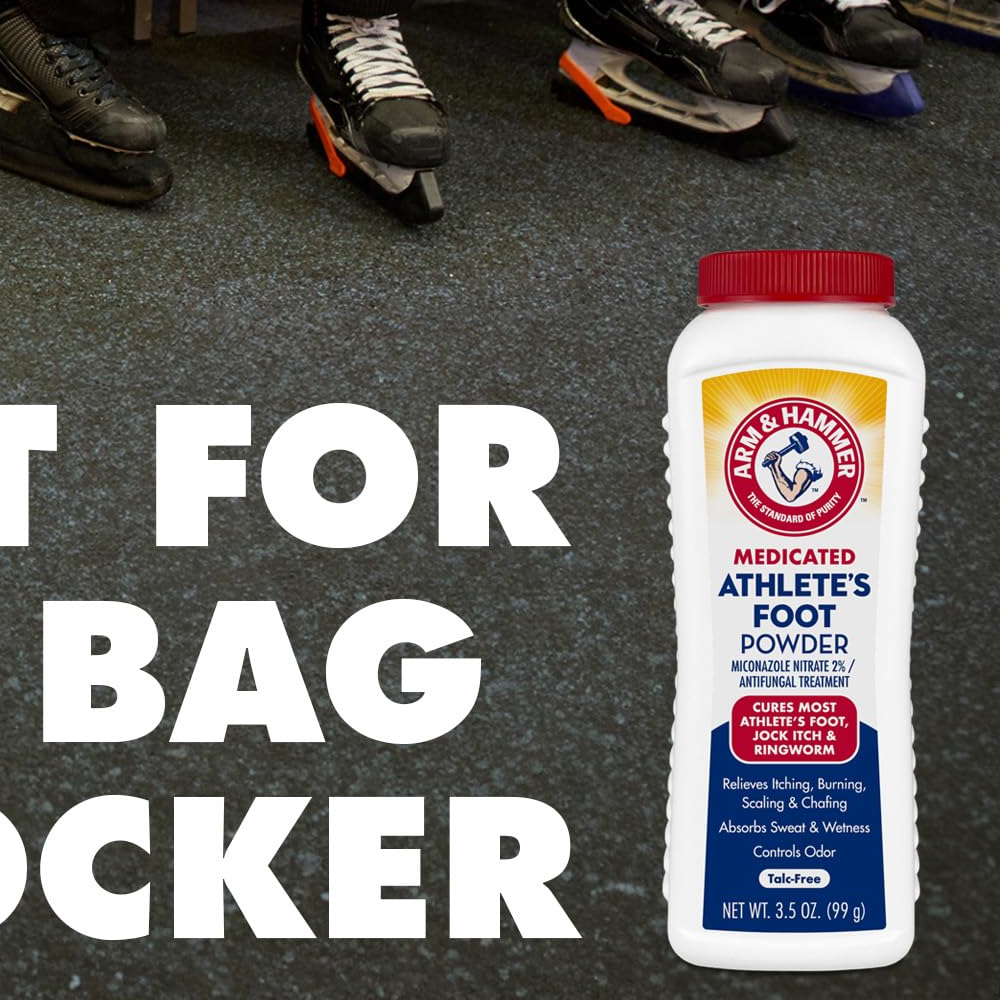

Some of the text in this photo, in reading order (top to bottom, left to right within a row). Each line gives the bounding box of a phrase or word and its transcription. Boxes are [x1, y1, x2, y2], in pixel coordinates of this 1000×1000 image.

[733, 406, 856, 479] ARM & HAMMER
[747, 491, 842, 523] THE STANDARD OF PURITY
[733, 548, 856, 566] MEDICATED
[753, 603, 836, 628] FOOT
[741, 634, 848, 654] POWDER
[731, 659, 855, 673] MICONAZOLE NITRATE 2% /
[739, 676, 850, 688] ANTIFUNGAL TREATMENT
[752, 702, 837, 713] CURES MOST
[809, 716, 849, 729] FOOT,
[752, 730, 837, 741] JOCK ITCH &
[754, 744, 835, 756] RINGWORM
[722, 777, 867, 793] Relieves Itching, Burning,
[741, 796, 848, 812] Scaling & Chafing
[718, 820, 871, 834] Absorbs Sweat & Wetness
[752, 844, 837, 858] Controls Odor
[767, 872, 821, 884] Talc-Free
[722, 902, 866, 923] NET WT. 3.5 OZ. (99 g)
